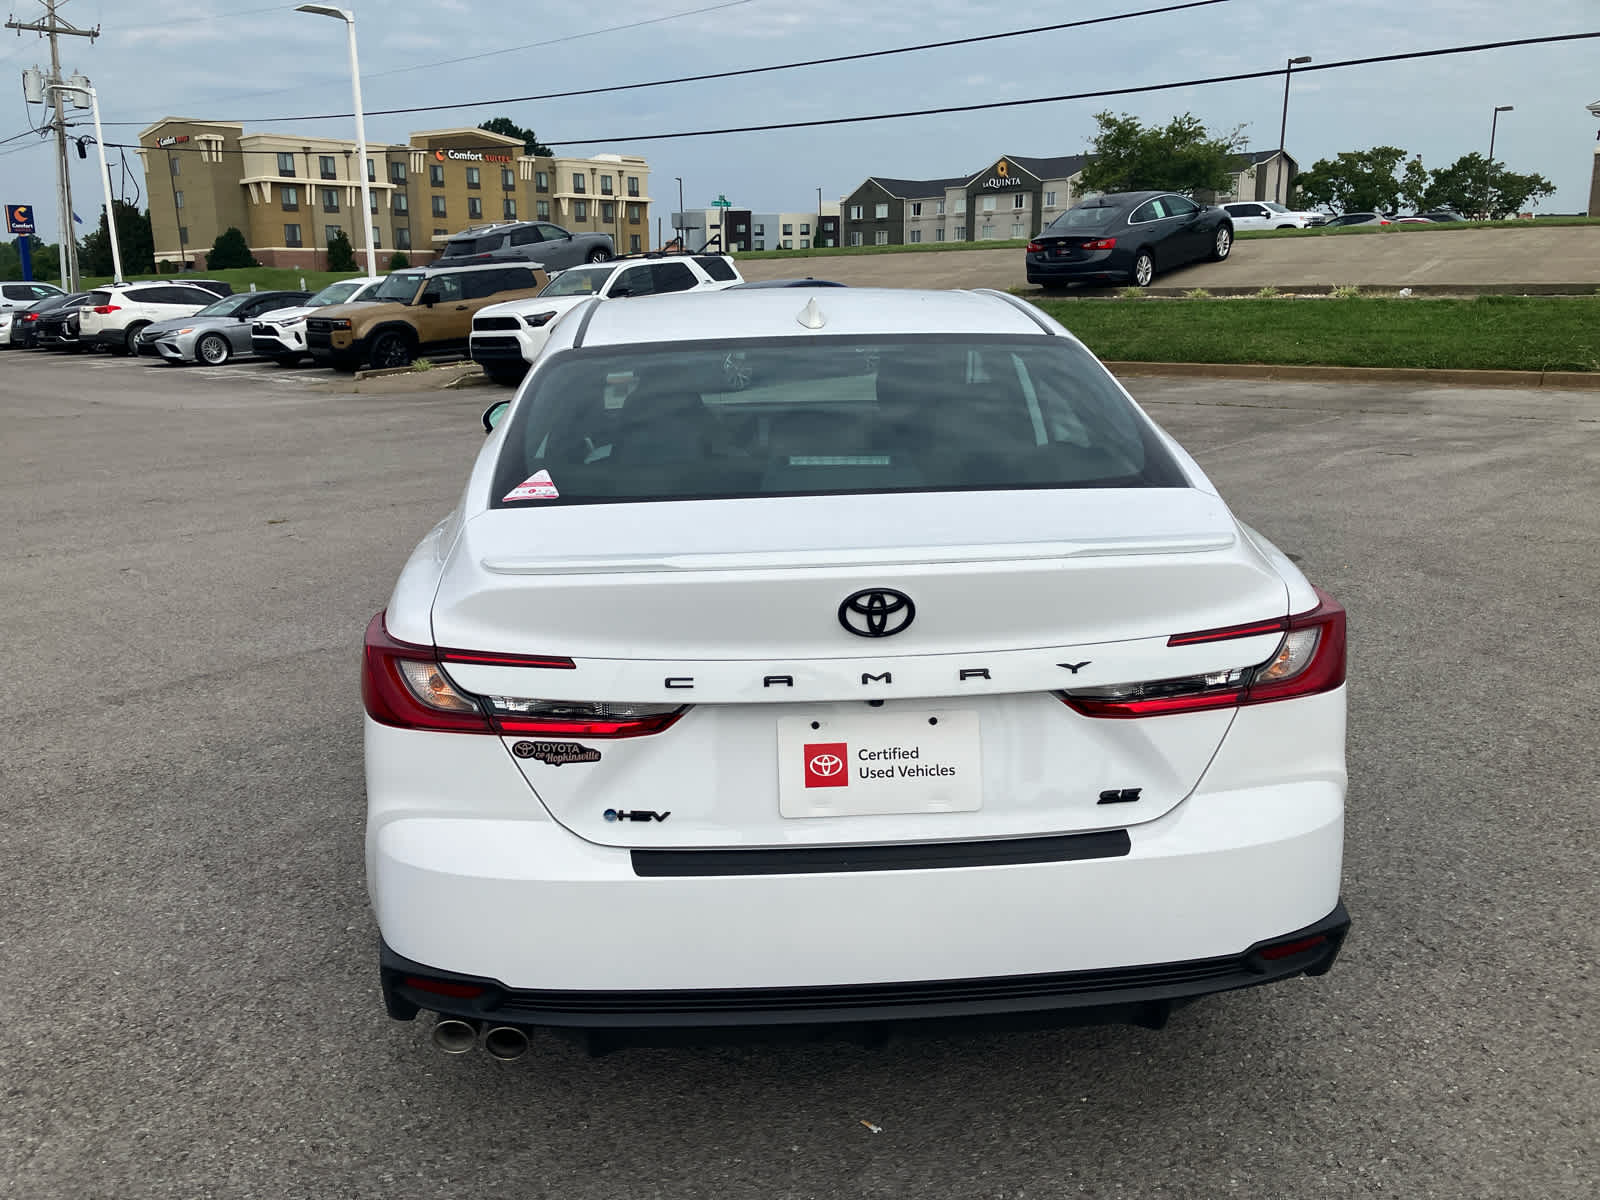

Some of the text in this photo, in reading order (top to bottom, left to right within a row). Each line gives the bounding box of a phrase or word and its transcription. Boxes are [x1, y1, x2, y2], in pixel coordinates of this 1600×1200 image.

[448, 150, 482, 160] Comfort
[989, 177, 1021, 188] QUINTA
[664, 660, 1092, 689] CAMRY
[535, 743, 580, 753] TOYOTA
[858, 746, 919, 761] Certified
[545, 751, 600, 764] Hopkinsville
[859, 763, 956, 779] Used Vehicles
[1096, 787, 1143, 805] SE
[617, 810, 671, 823] HEV
